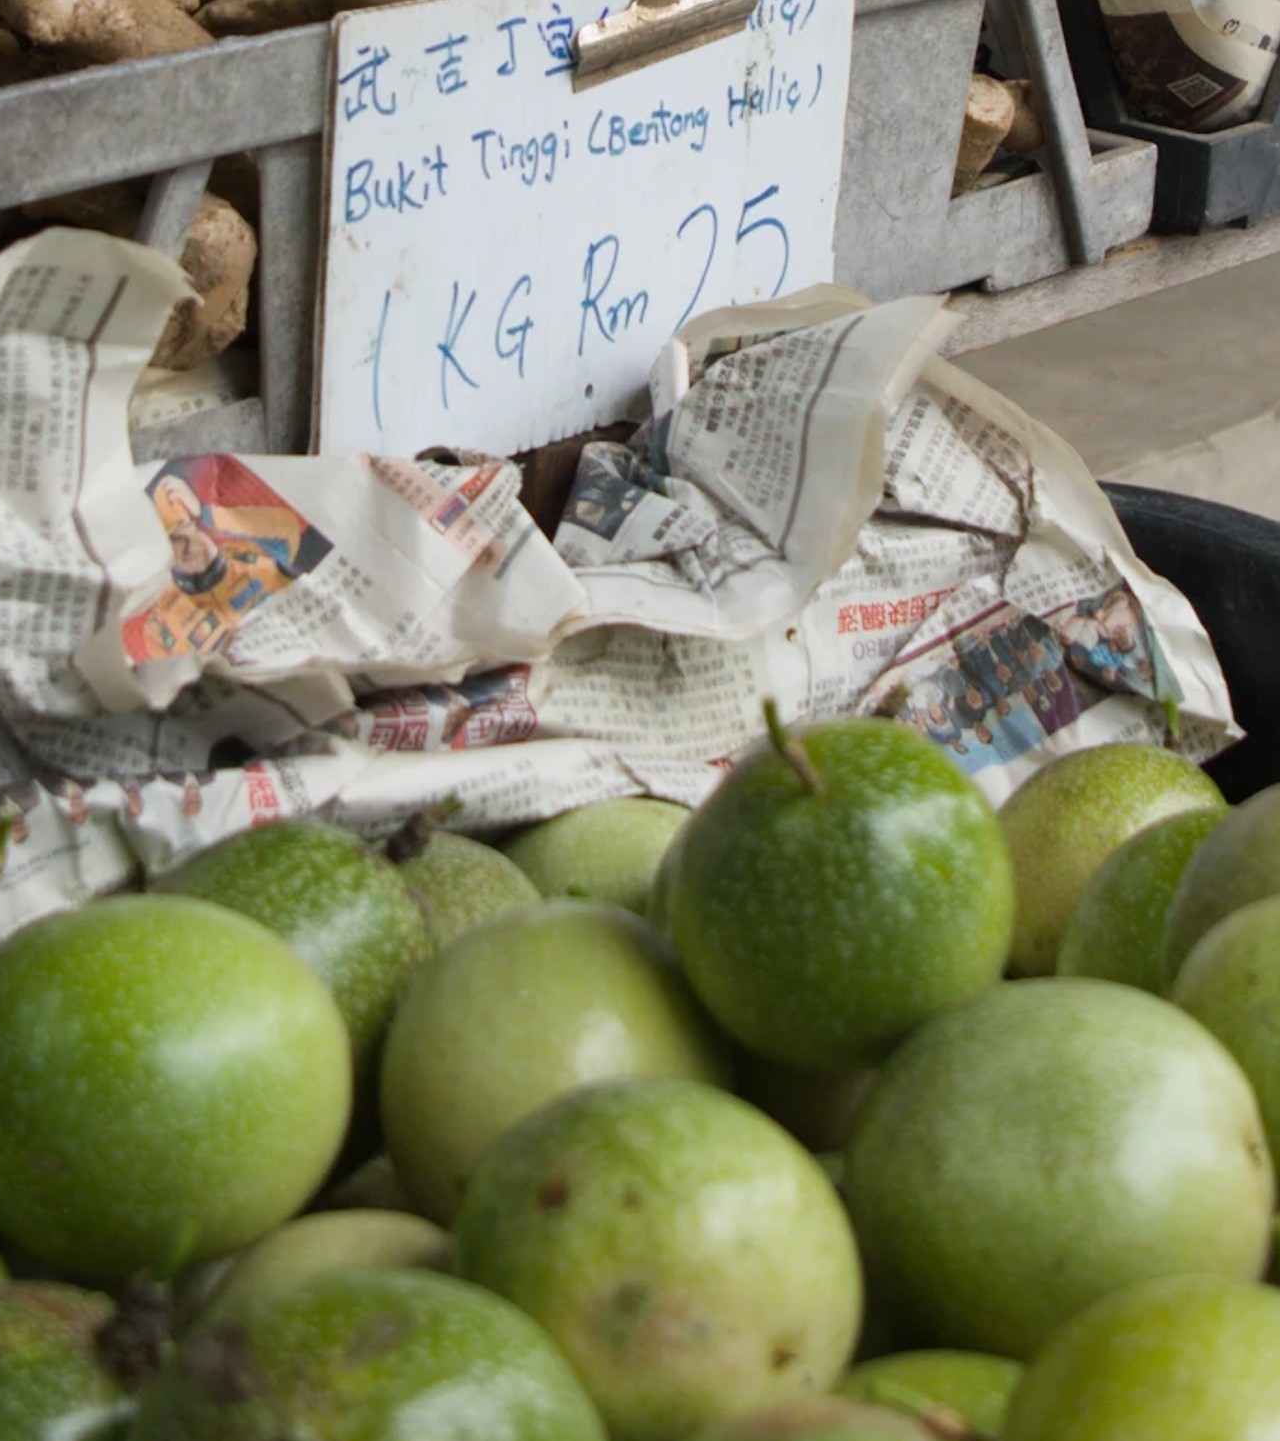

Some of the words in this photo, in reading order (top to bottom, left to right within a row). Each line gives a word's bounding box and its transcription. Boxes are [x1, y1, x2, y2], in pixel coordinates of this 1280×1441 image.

[344, 144, 449, 223] Bukit
[471, 118, 571, 186] Tinggi
[587, 100, 712, 156] (Bentong
[435, 274, 535, 411] KG
[576, 233, 650, 357] Rm
